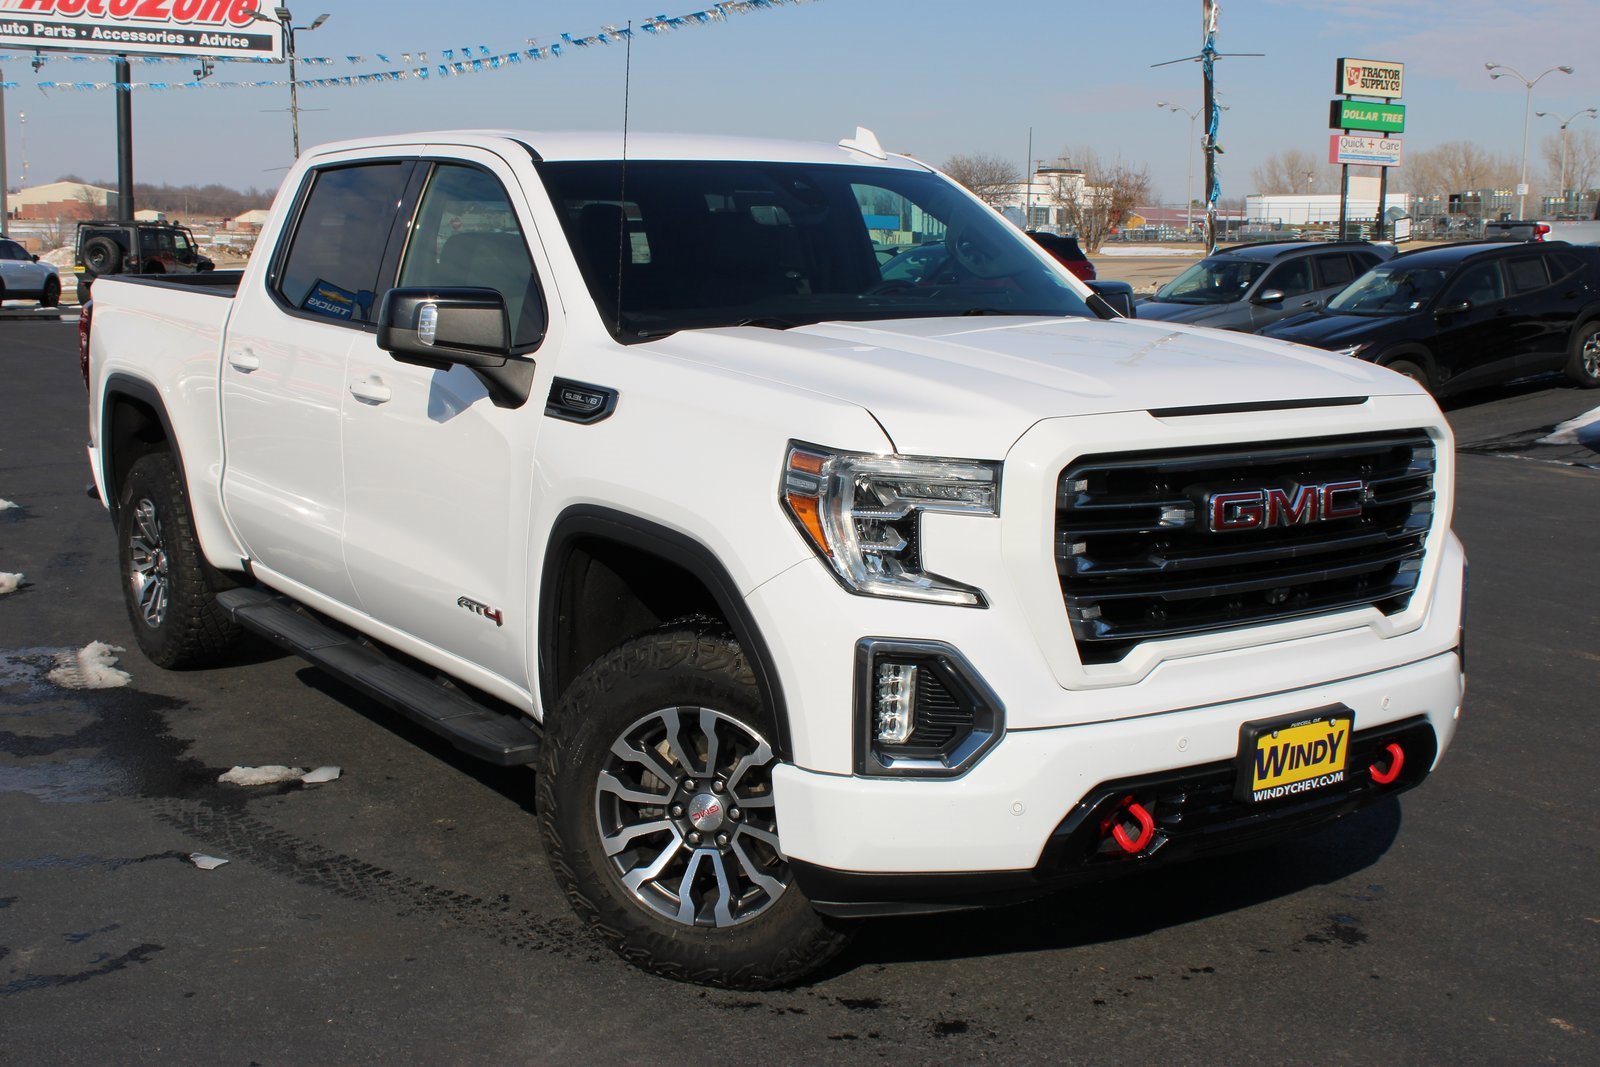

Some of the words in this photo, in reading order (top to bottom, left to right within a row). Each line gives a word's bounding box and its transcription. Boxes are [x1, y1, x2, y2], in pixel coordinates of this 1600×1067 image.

[18, 0, 258, 24] oZone
[0, 23, 28, 35] uto
[33, 23, 77, 38] Parts
[91, 27, 185, 43] Accessories
[199, 33, 249, 48] Advice
[1360, 78, 1390, 90] SUPPLY
[1361, 67, 1400, 80] TRACTOR
[1343, 110, 1378, 121] DOLLAR
[1381, 113, 1403, 123] TREE
[1340, 137, 1365, 149] Quick
[1379, 141, 1400, 151] Care
[1209, 480, 1363, 532] GMC
[457, 596, 503, 627] AT4
[1255, 730, 1345, 781] WINDY
[1253, 771, 1344, 802] WINDYCHEV.COM
